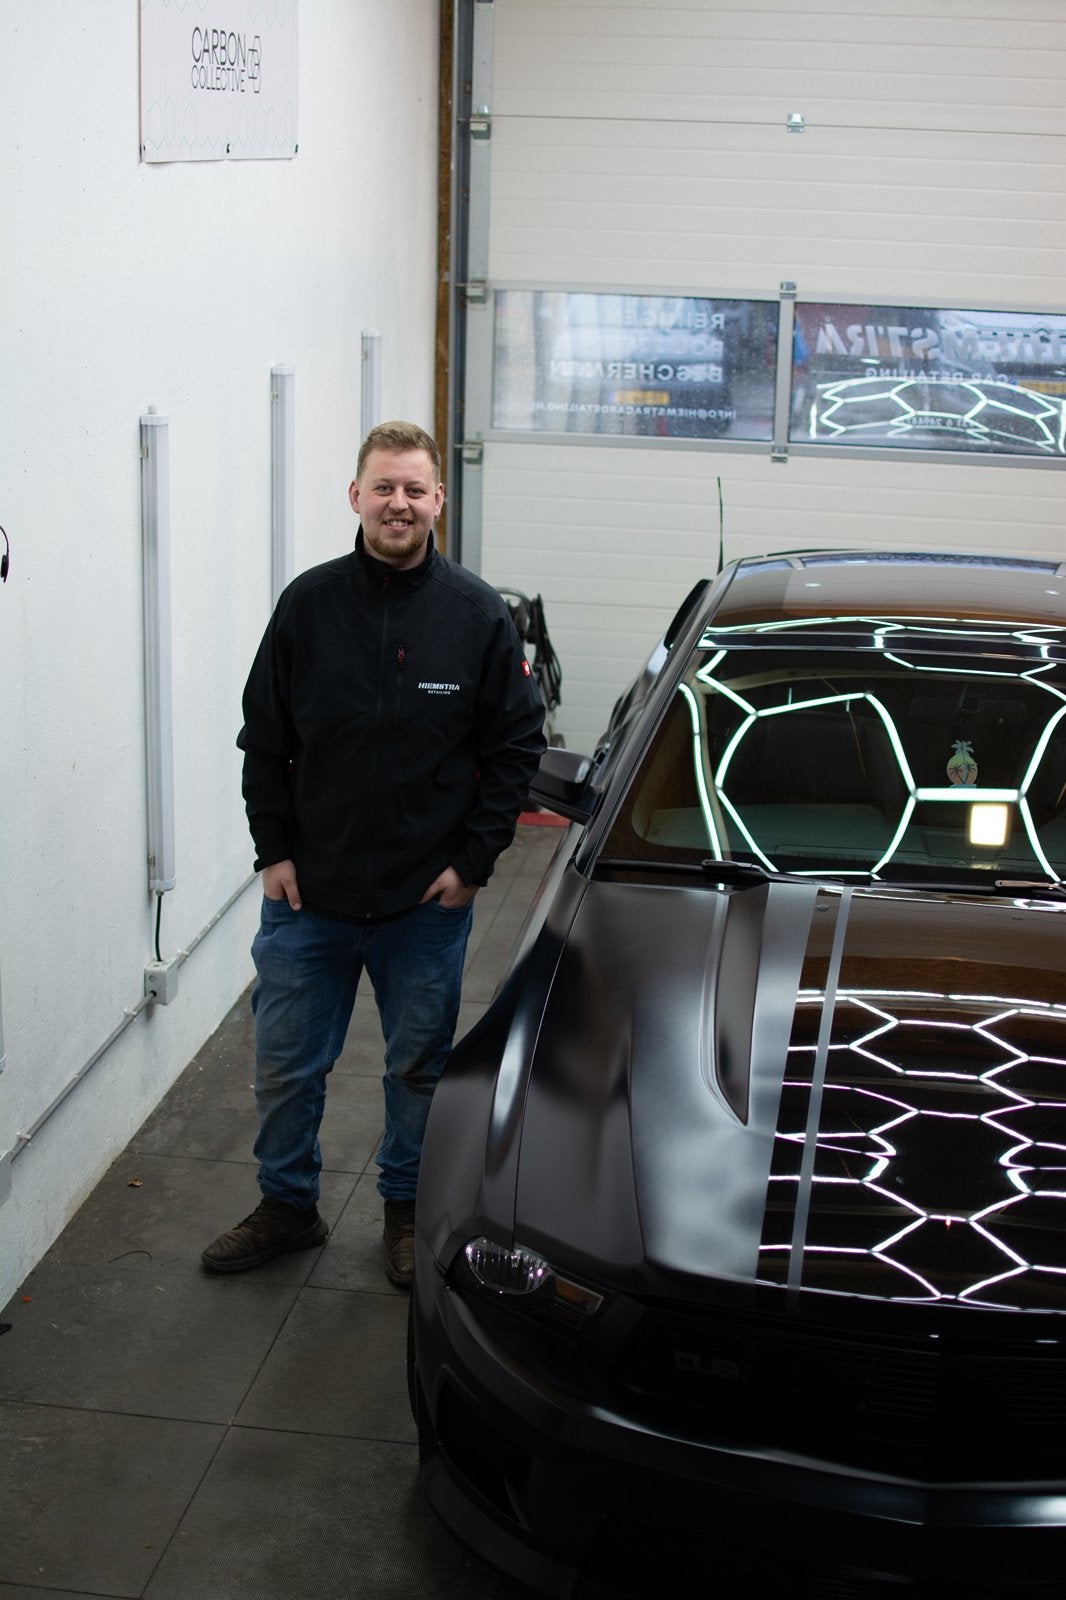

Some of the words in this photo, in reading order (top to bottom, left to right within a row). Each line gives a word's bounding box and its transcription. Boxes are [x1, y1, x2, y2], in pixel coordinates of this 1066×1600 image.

[192, 26, 246, 67] CARBON
[191, 64, 246, 92] COLLECTIVE
[418, 682, 460, 691] HIEMSTRA
